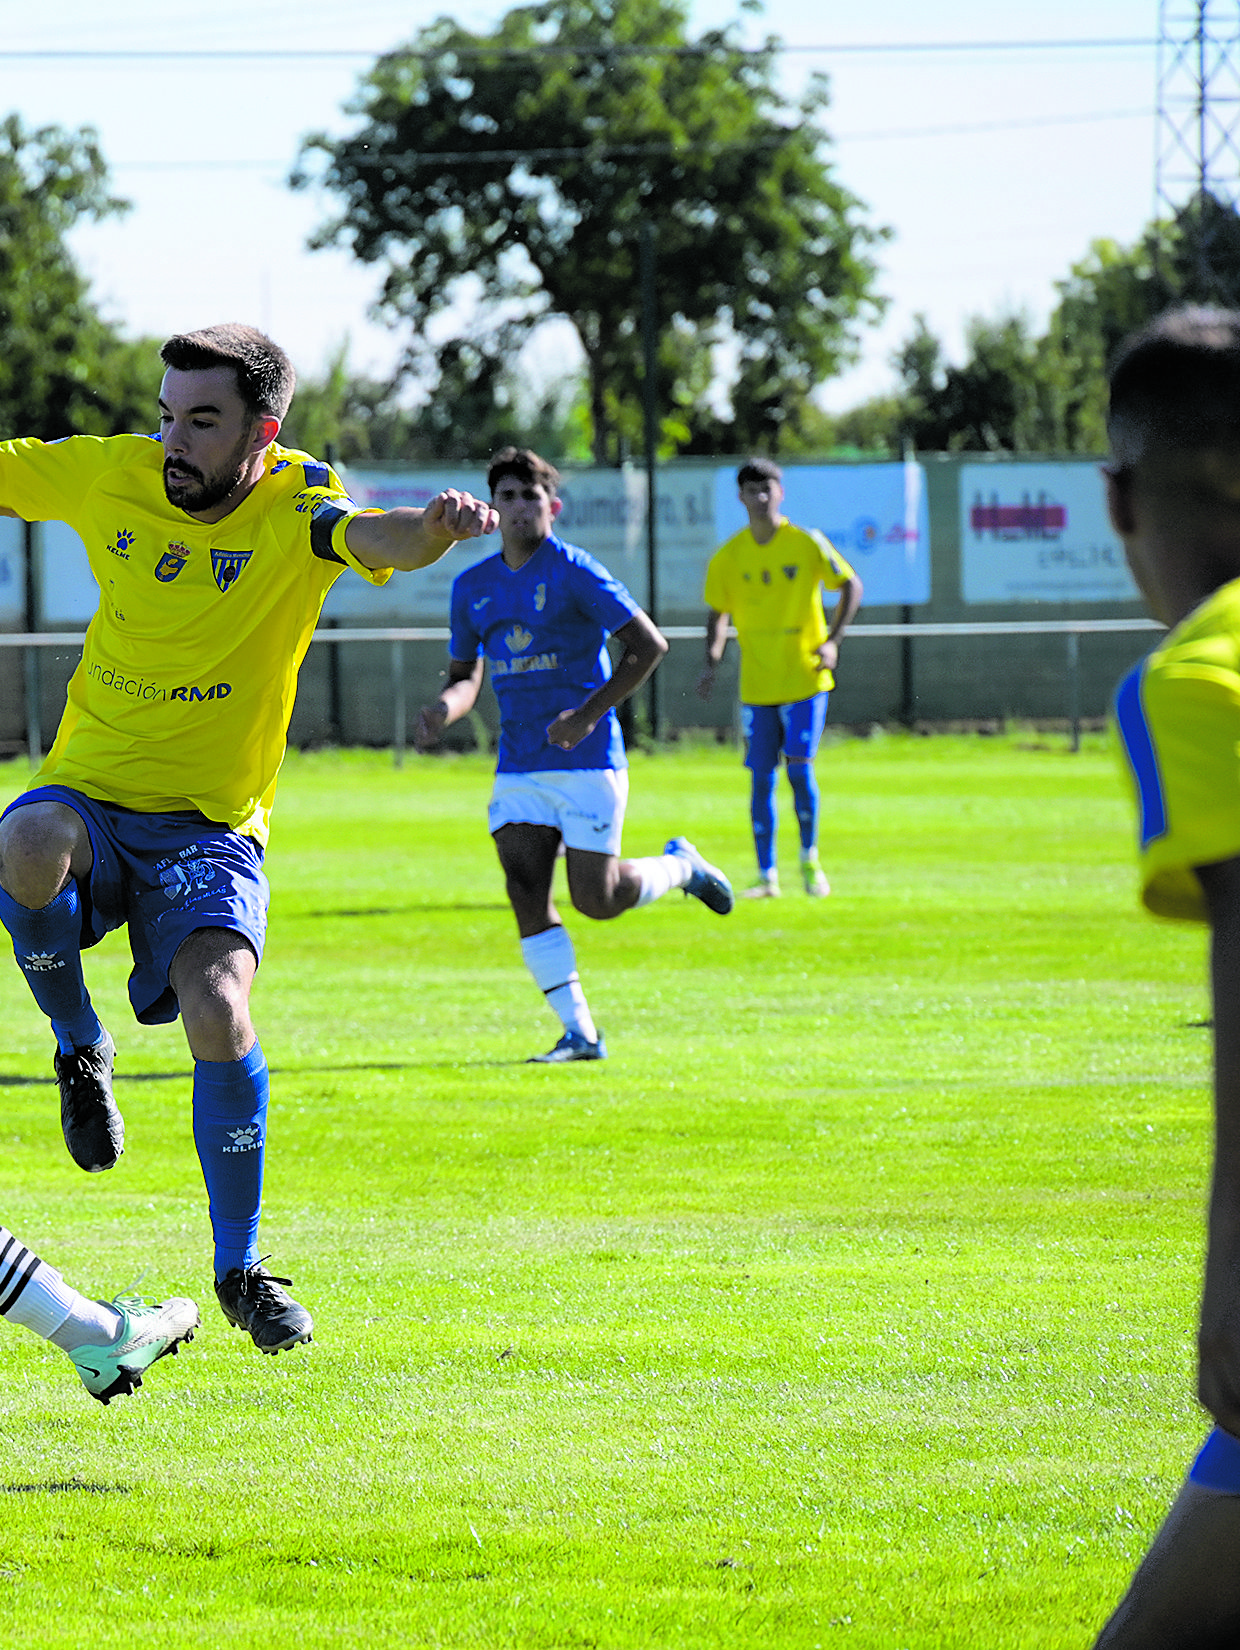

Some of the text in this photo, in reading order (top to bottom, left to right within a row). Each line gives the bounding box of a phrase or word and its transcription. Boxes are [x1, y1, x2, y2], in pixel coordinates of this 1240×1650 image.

[106, 544, 131, 560] KELME
[170, 682, 232, 702] RMD
[179, 844, 198, 859] BAR
[23, 959, 65, 973] KELME
[222, 1139, 263, 1153] KELME
